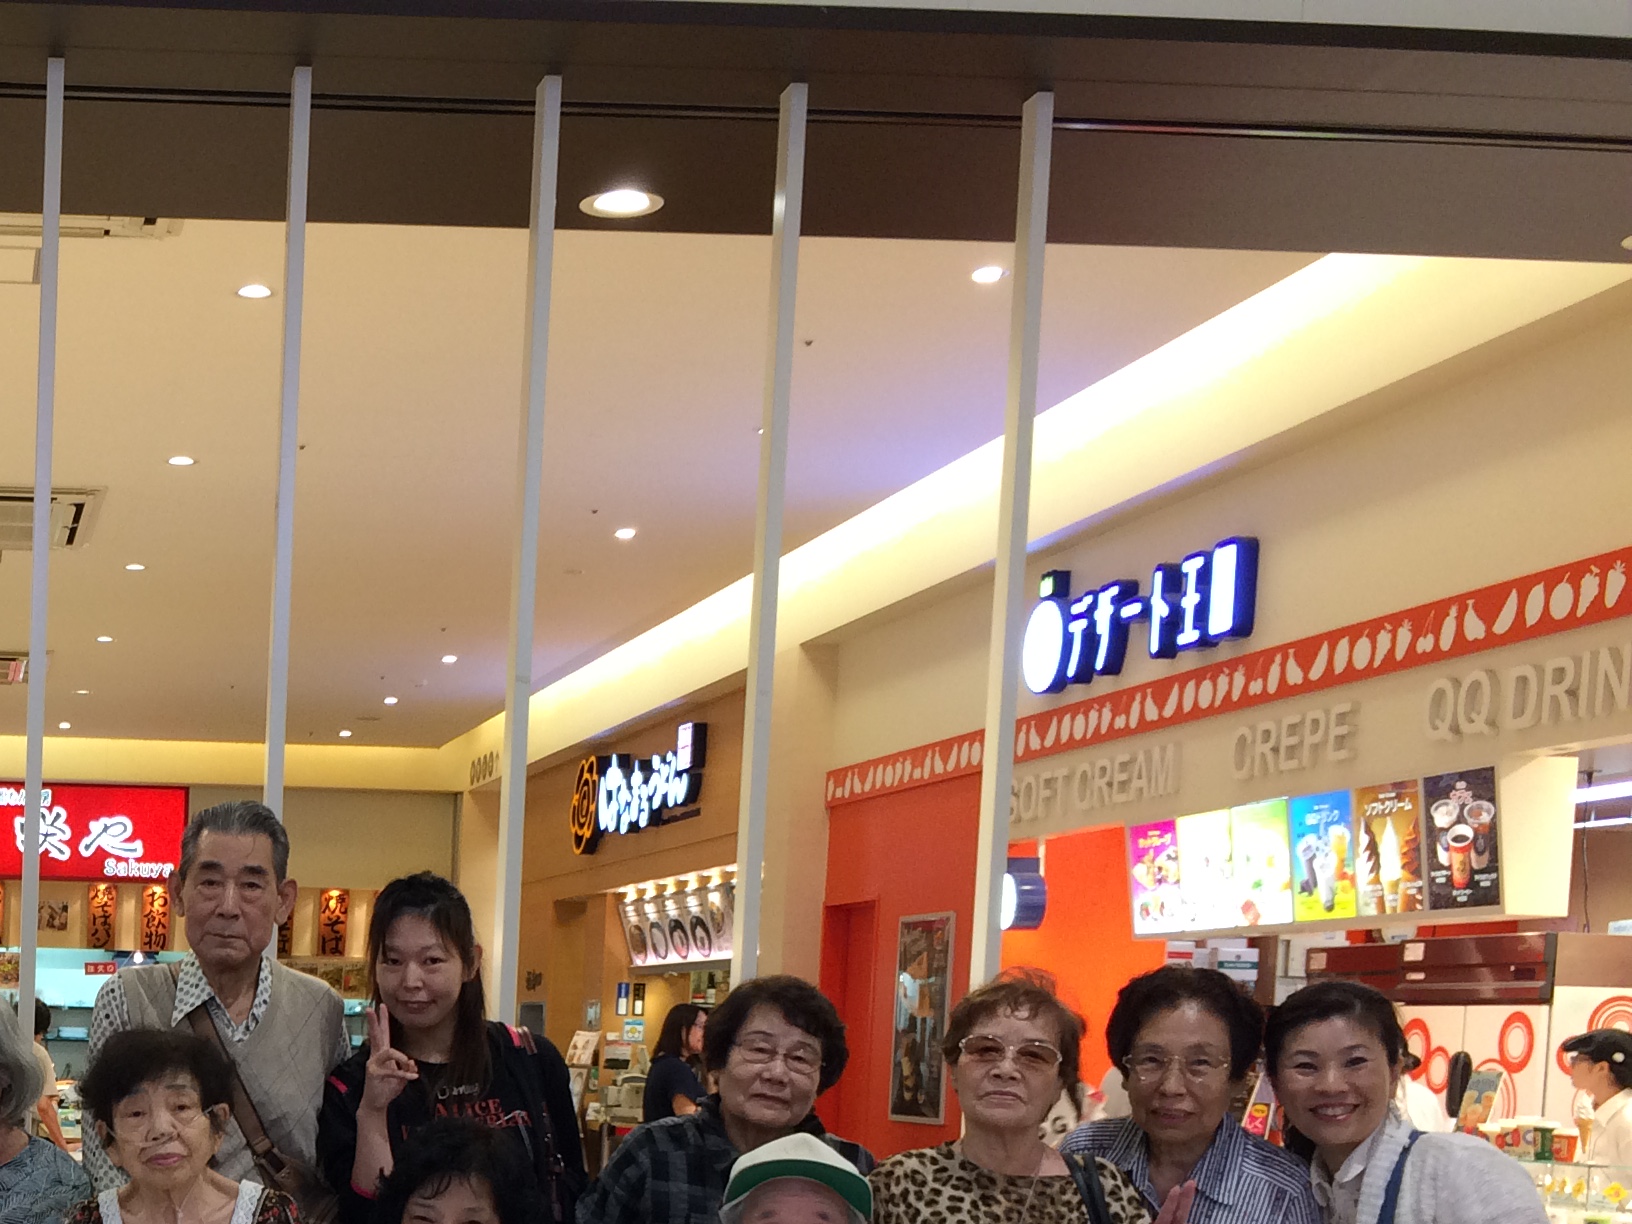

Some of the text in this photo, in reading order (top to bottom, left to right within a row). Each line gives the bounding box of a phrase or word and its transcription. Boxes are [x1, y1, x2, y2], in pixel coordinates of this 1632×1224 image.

[1426, 669, 1492, 741] QQ
[1232, 702, 1353, 780] CREPE
[1073, 742, 1178, 810] CREAM
[142, 888, 168, 950] お飲物
[321, 893, 348, 956] 焼そば
